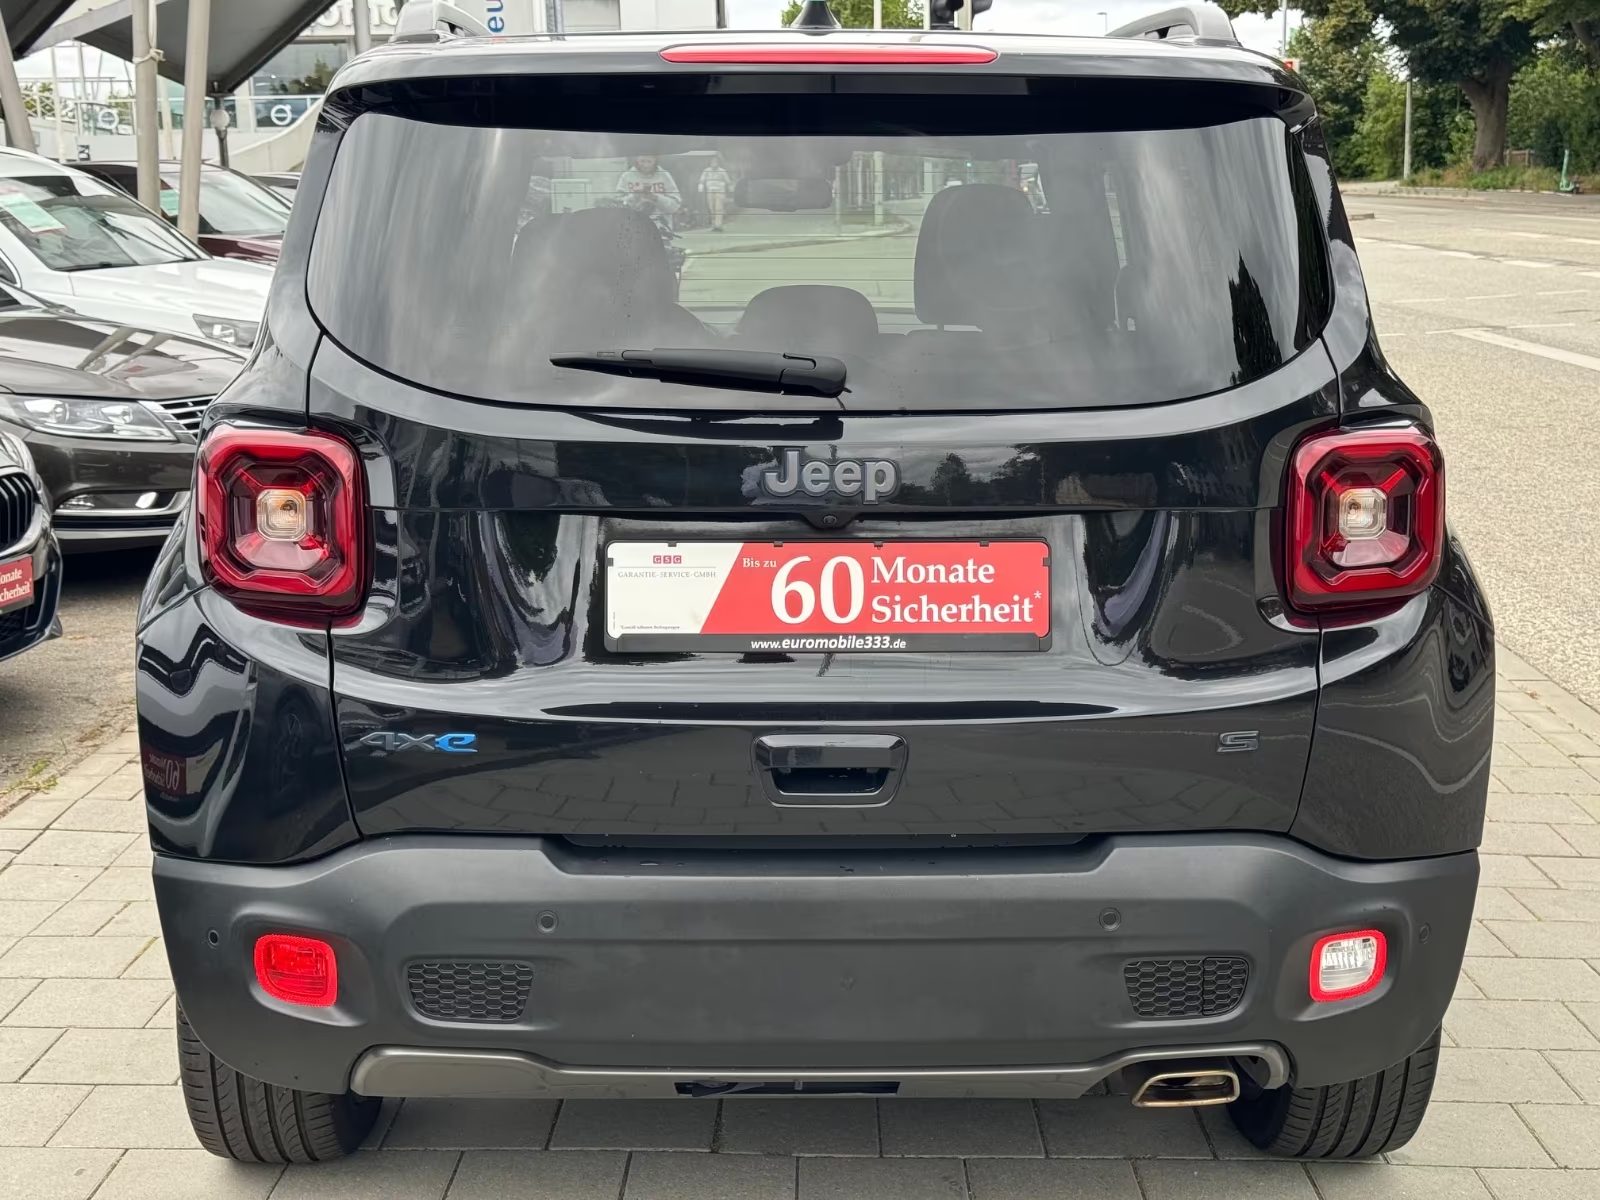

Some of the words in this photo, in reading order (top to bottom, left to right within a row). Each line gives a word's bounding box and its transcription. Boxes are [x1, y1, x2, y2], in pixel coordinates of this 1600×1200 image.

[763, 448, 898, 504] Jeep
[653, 555, 682, 564] GSG
[743, 557, 761, 568] Bis
[763, 560, 777, 568] zu
[0, 568, 22, 585] onate
[871, 556, 995, 584] Monate
[771, 555, 865, 624] 60
[751, 635, 907, 649] www.euromobile333.de
[1217, 730, 1259, 752] S
